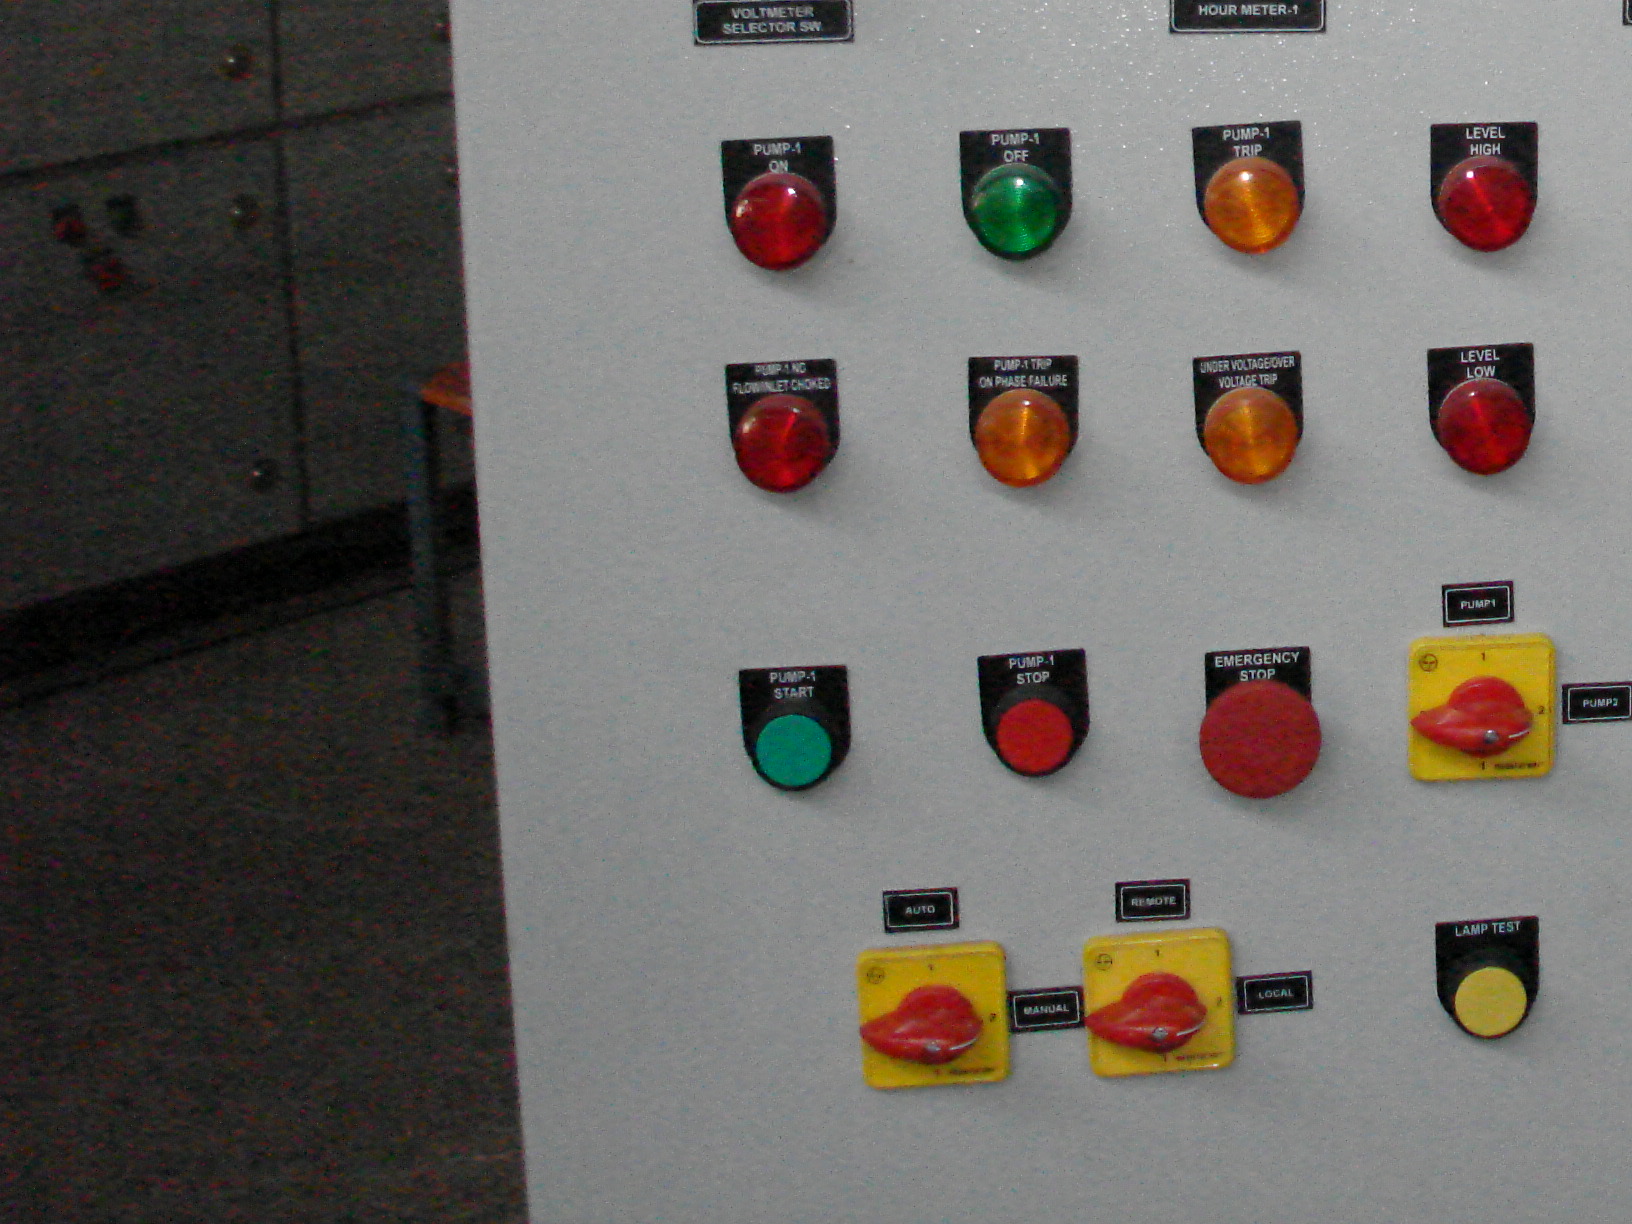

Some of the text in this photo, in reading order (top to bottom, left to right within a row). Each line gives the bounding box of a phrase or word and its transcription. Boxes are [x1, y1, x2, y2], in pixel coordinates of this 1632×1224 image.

[731, 6, 814, 19] VOLTMETER
[1198, 4, 1299, 16] HOUR METER-1
[723, 22, 795, 34] SELECTOR
[991, 133, 1040, 145] PUMP-1
[1223, 128, 1270, 141] PUMP-1
[1465, 127, 1506, 139] LEVEL
[754, 143, 801, 156] PUMP-1
[1233, 145, 1263, 158] TRIP
[1470, 143, 1501, 156] HIGH
[1003, 150, 1029, 163] OFF
[768, 160, 789, 173] ON
[1460, 349, 1500, 362] LEVEL
[994, 359, 1028, 371] PUMP-1
[1200, 360, 1230, 373] UNDER
[1466, 366, 1495, 378] LOW
[979, 374, 1068, 388] ON PHASE FAILURE
[1219, 374, 1278, 388] VOLTAGE TRIP
[1009, 655, 1055, 670] PUMP-1
[1215, 652, 1299, 667] EMERGENCY
[768, 670, 816, 684] PUMP-1
[1016, 671, 1050, 685] STOP
[1240, 669, 1276, 681] STOP
[773, 686, 815, 699] START
[1131, 896, 1177, 906] REMOTE
[905, 905, 936, 914] AUTO
[1455, 921, 1520, 936] LAMP TEST
[1259, 988, 1293, 999] LOCAL
[1023, 1004, 1069, 1015] MANUAL
